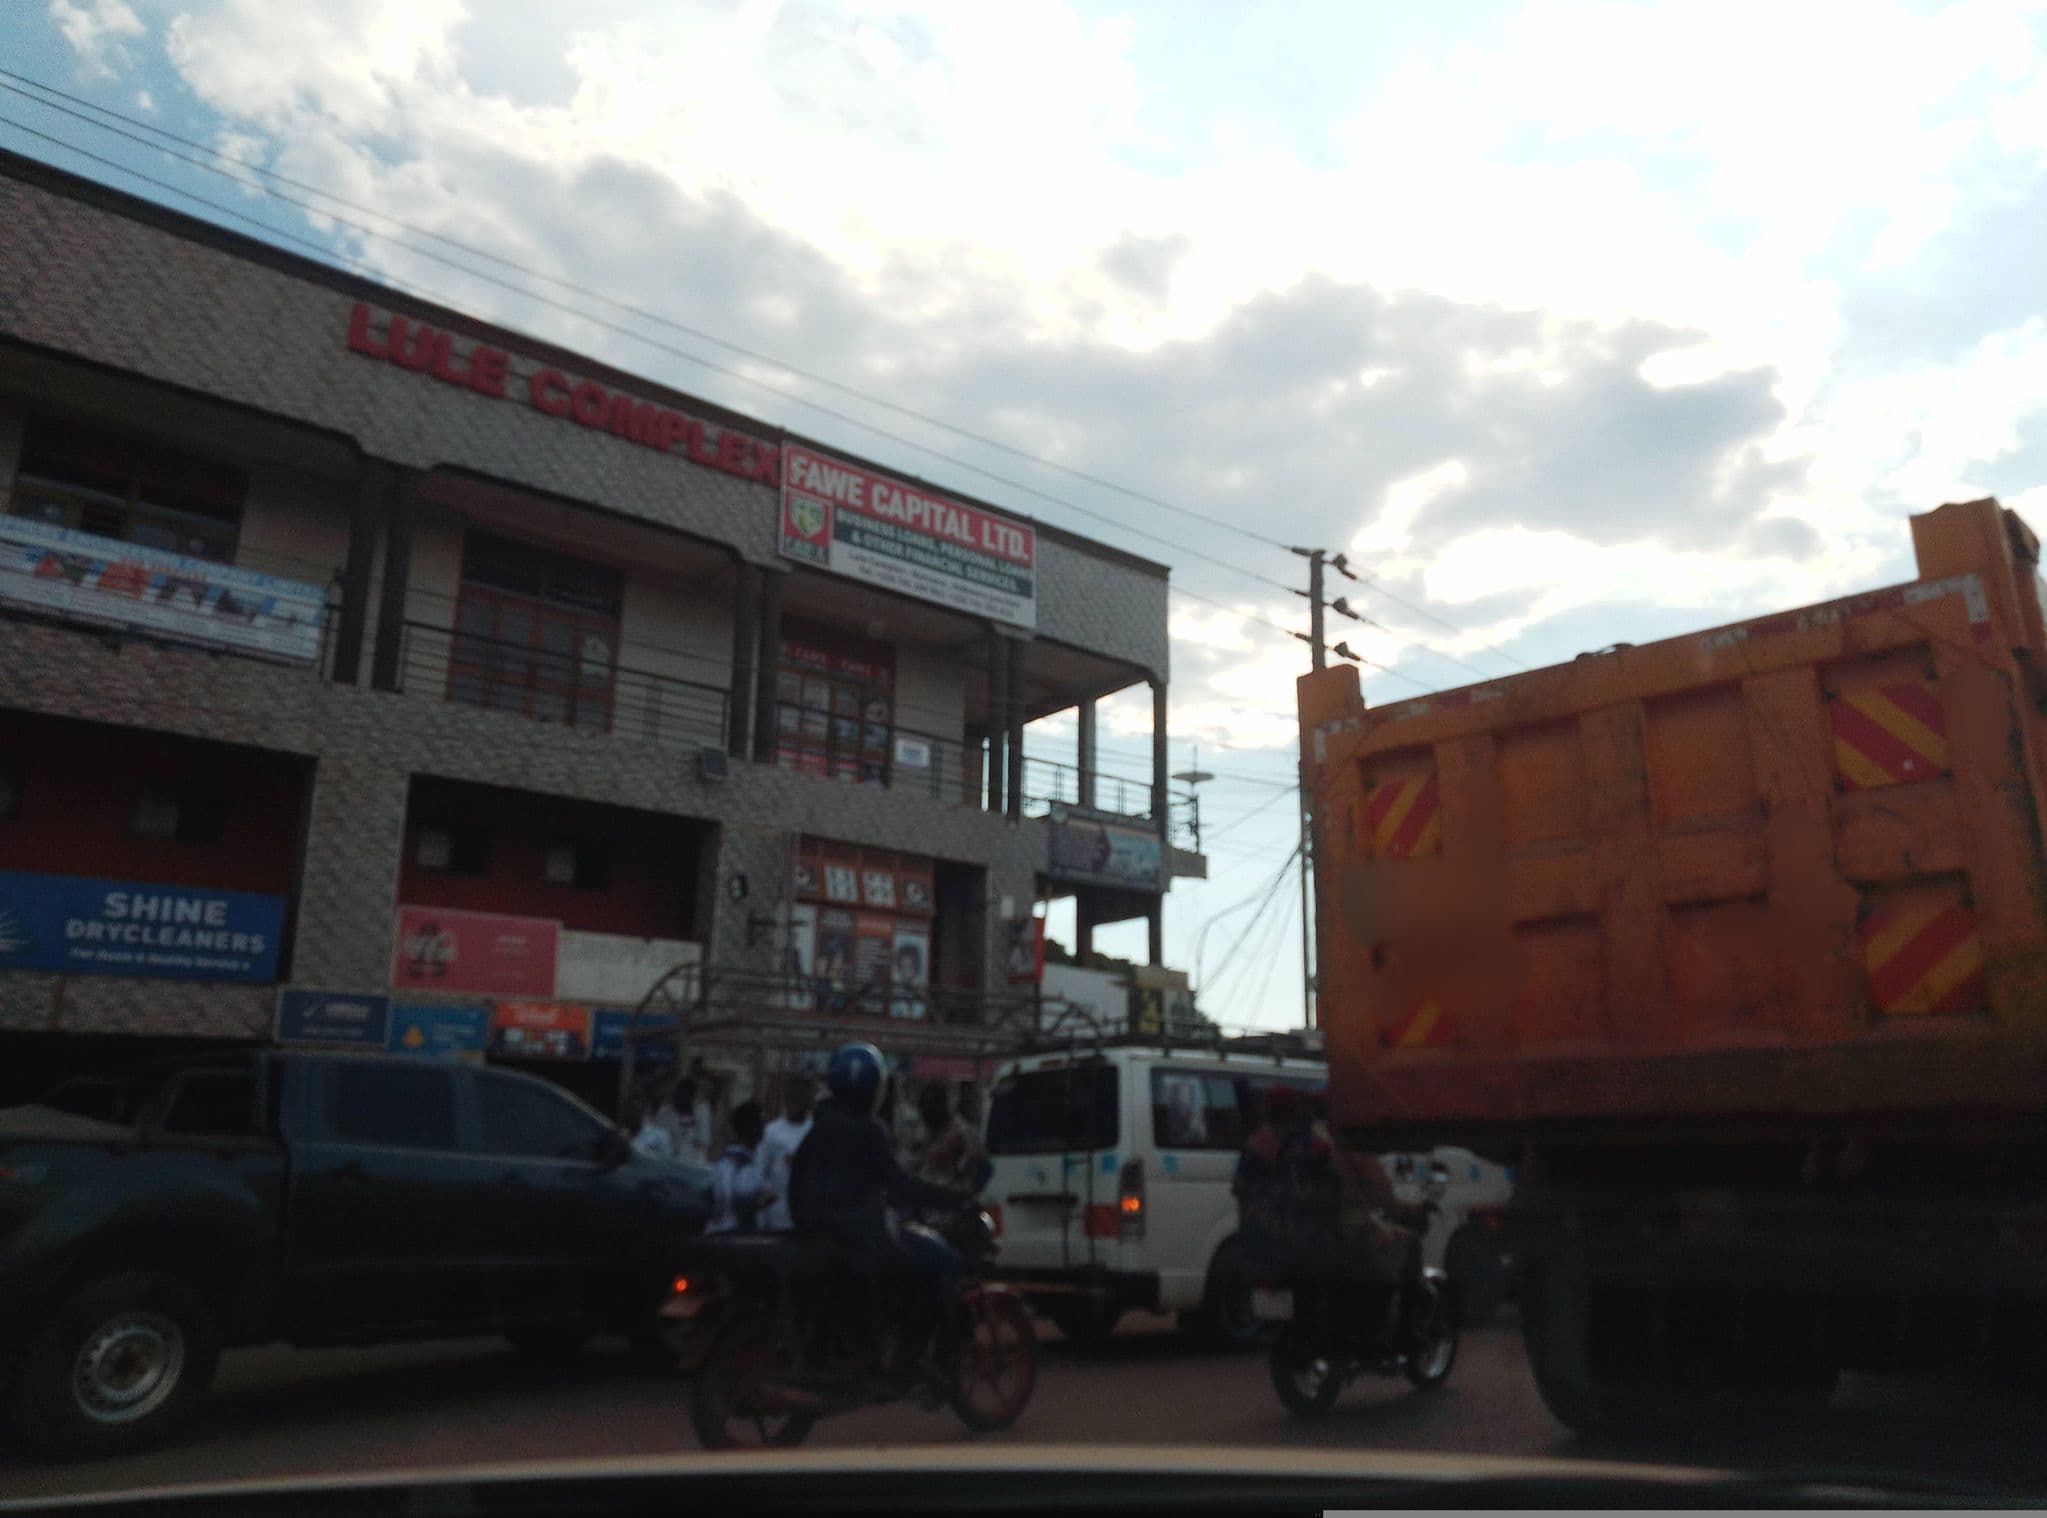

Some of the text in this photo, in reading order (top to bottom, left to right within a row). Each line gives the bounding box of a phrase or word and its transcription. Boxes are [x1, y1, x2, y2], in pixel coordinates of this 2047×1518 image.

[347, 303, 779, 489] LULE COMPLEX
[790, 456, 1030, 561] FAWE CAPITAL LTD.
[65, 918, 266, 954] DRYCLEANERS
[104, 891, 229, 927] SHINE
